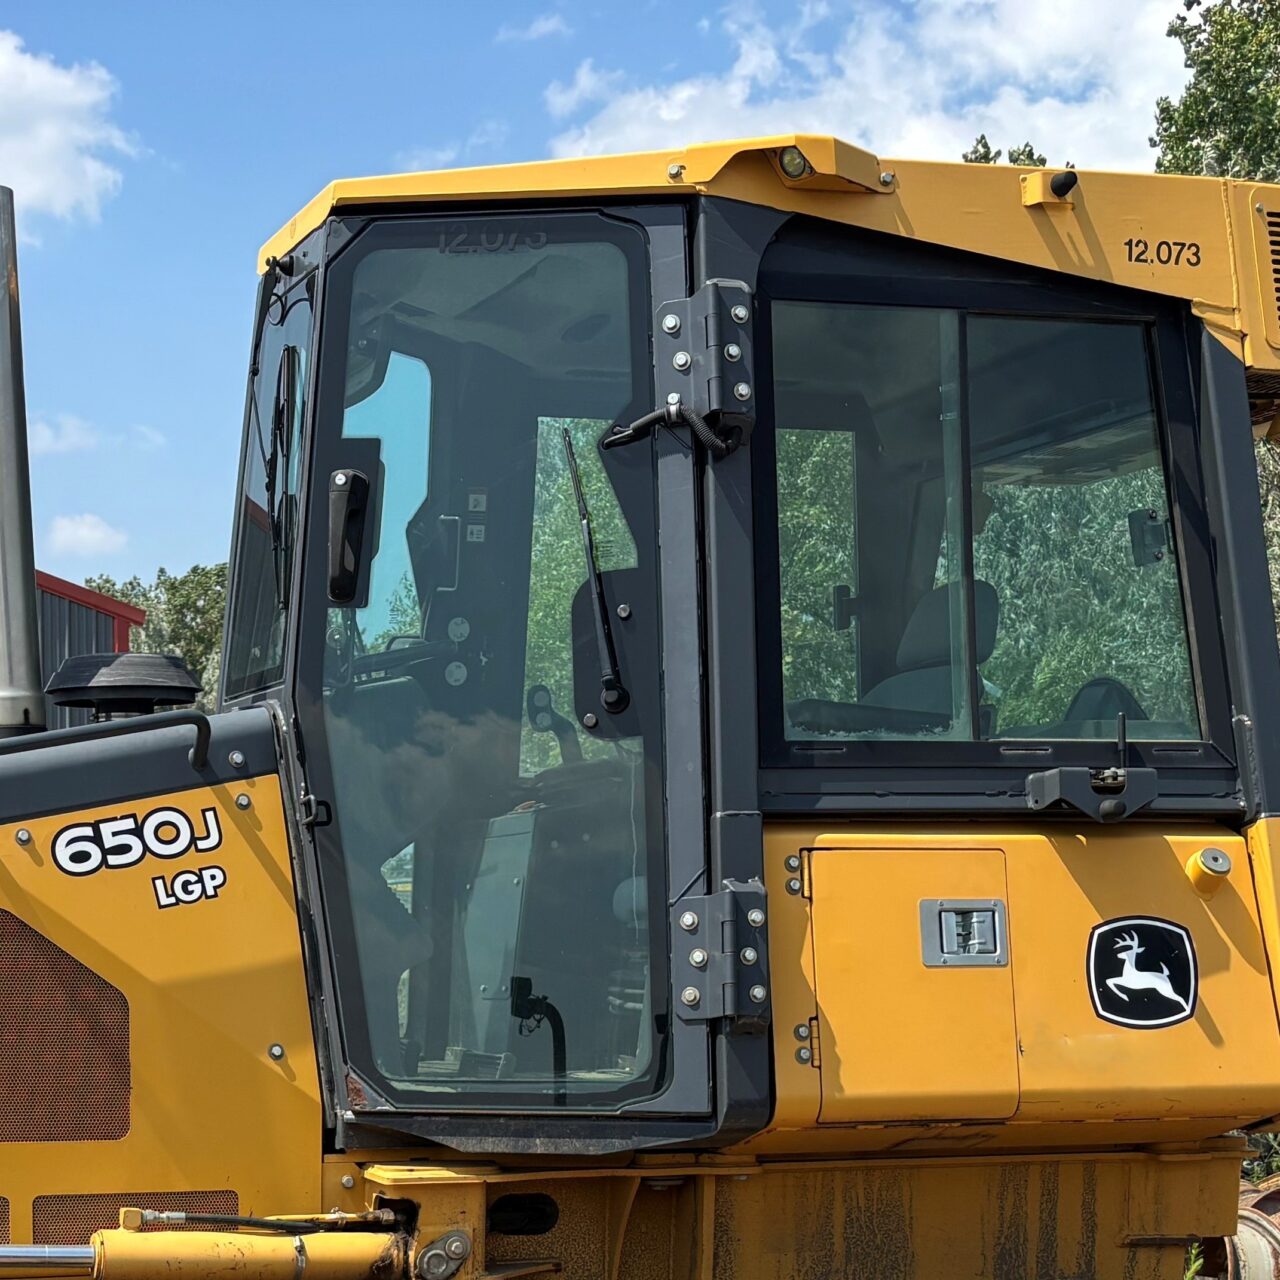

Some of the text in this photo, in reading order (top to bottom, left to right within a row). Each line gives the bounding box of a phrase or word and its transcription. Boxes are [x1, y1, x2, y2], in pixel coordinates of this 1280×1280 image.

[1123, 238, 1202, 267] 12.073
[52, 806, 223, 876] 650J
[152, 865, 227, 909] LGP
